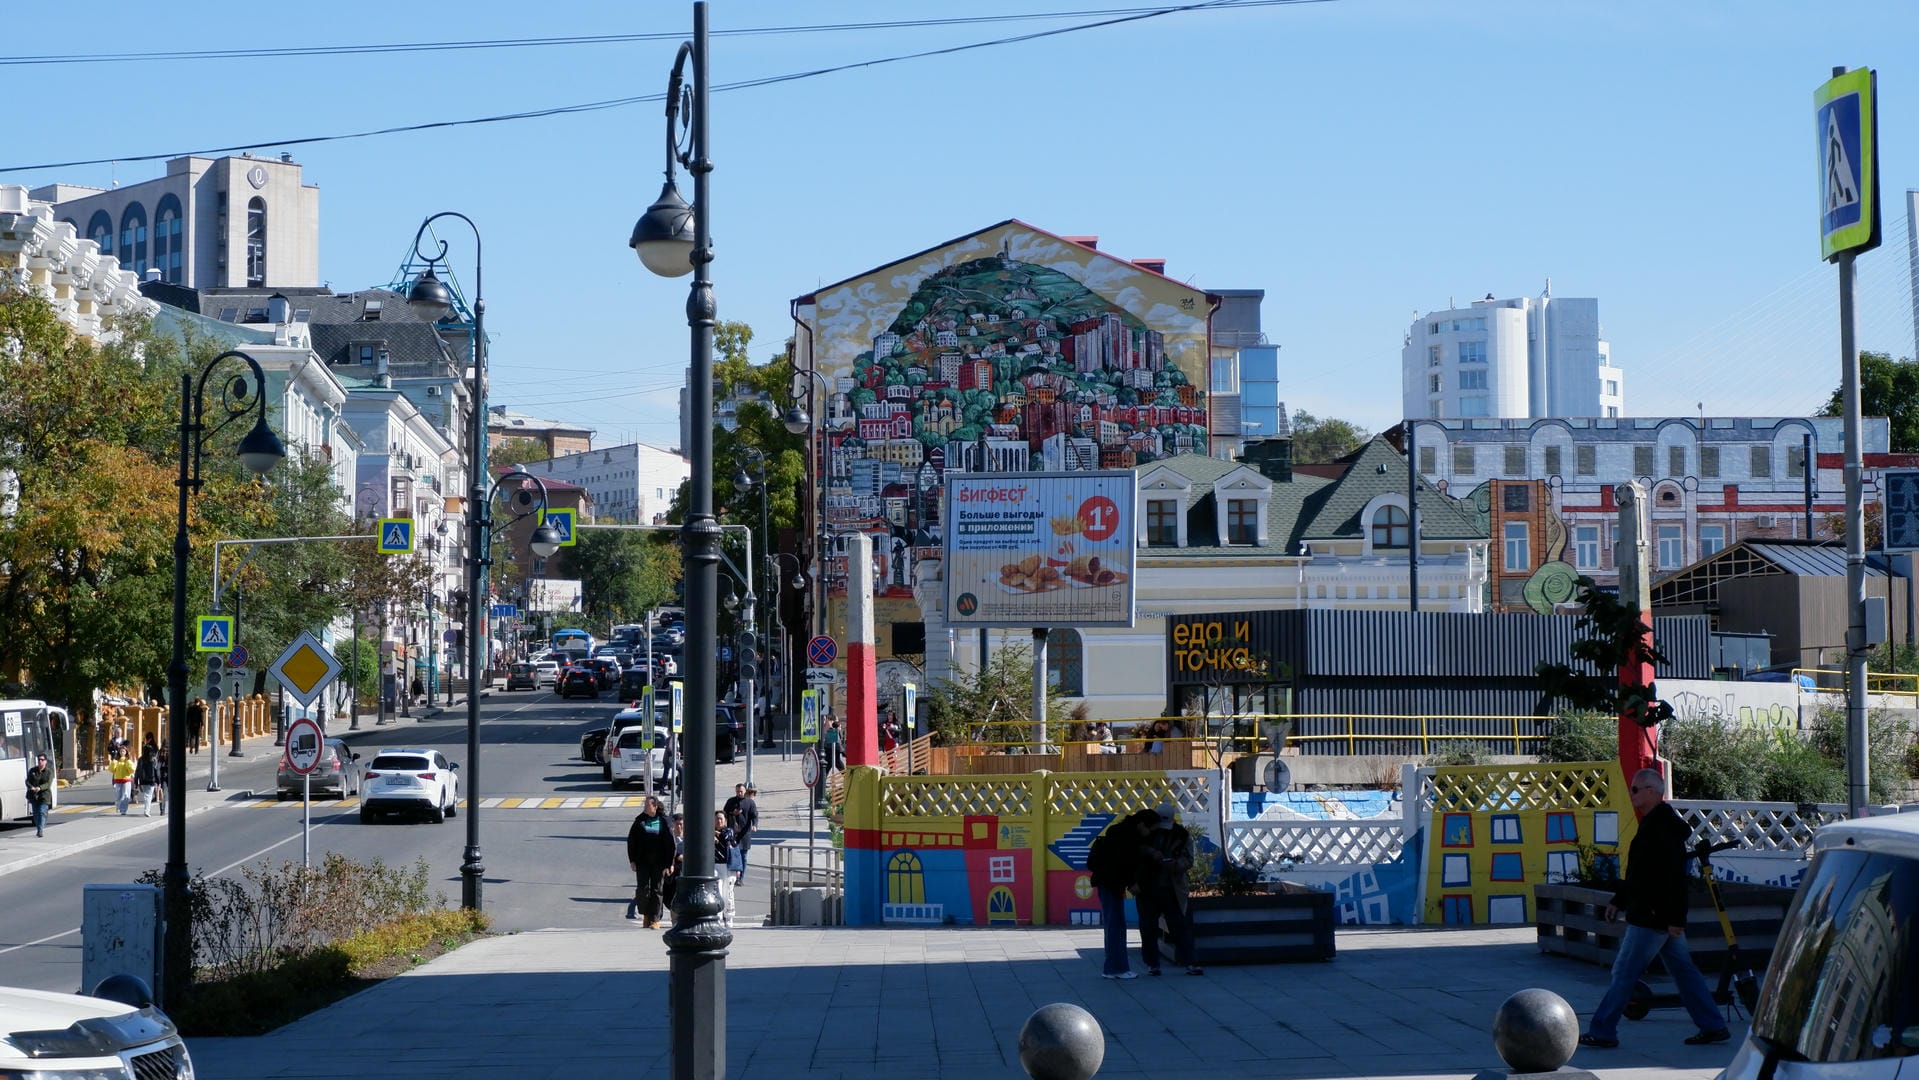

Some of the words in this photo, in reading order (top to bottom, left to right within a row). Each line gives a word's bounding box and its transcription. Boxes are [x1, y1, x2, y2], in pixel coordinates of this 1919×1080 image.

[960, 488, 1027, 503] БИГФЕСТ
[959, 510, 1001, 520] Больше
[1003, 511, 1044, 520] выгоды
[967, 523, 1034, 534] приложении
[1174, 622, 1222, 649] еда
[1235, 620, 1249, 642] и
